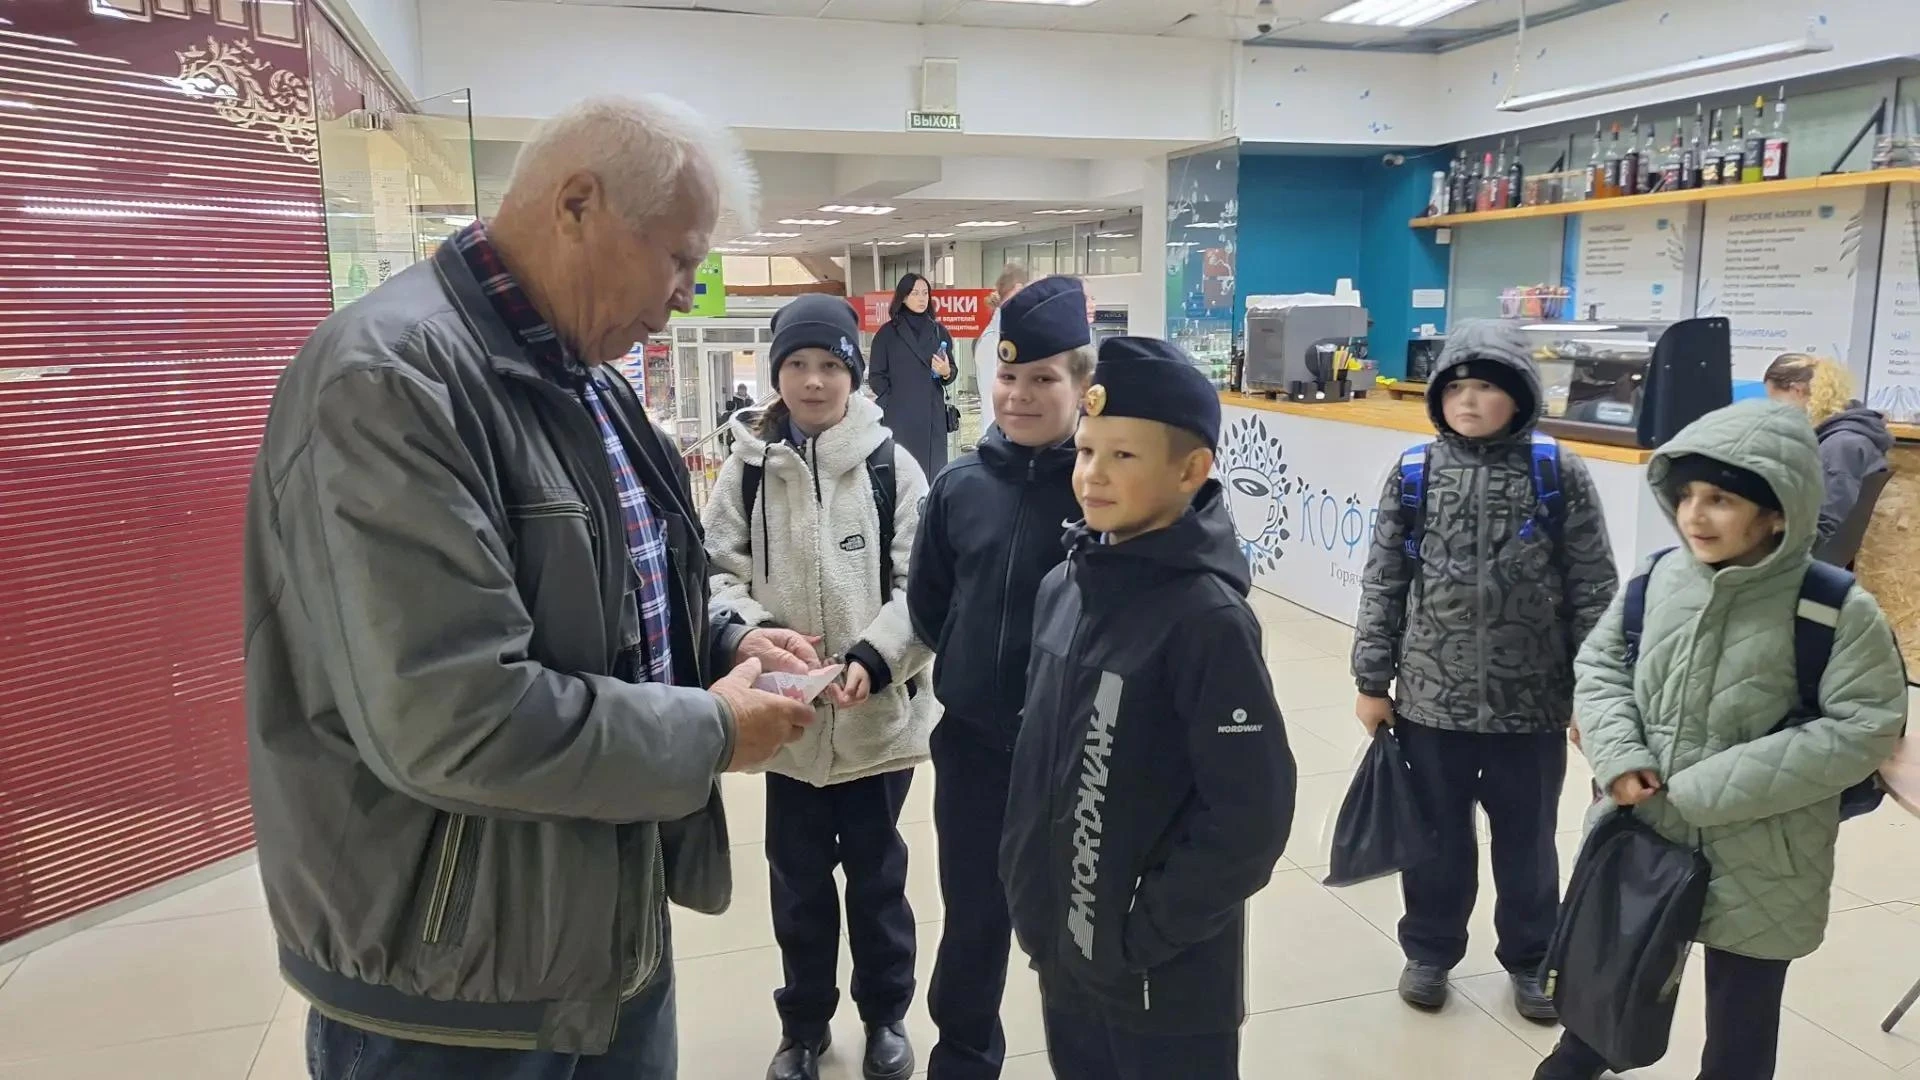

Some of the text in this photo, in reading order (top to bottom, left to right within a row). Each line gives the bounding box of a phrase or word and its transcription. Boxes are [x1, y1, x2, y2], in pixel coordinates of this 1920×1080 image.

[913, 114, 957, 129] ВЫХОД
[1330, 561, 1362, 587] Горяч
[1217, 724, 1263, 733] NORDWAY
[1067, 670, 1124, 960] NORDWAY
